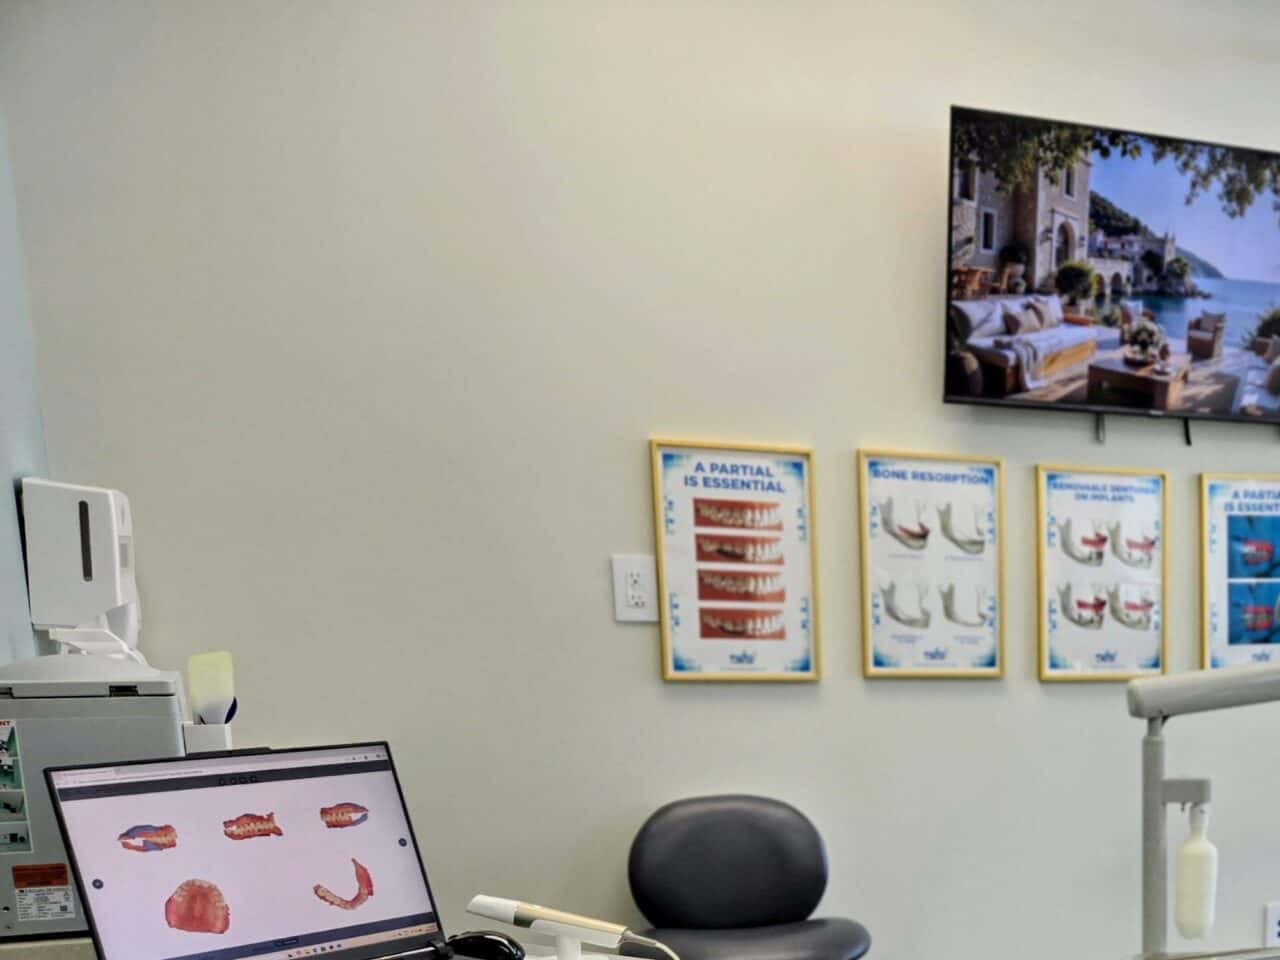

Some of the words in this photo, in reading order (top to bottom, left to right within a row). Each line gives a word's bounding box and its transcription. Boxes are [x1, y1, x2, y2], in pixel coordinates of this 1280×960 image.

[695, 461, 705, 472] A
[710, 462, 774, 477] PARTIAL
[684, 475, 698, 487] IS
[703, 476, 785, 493] ESSENTIAL
